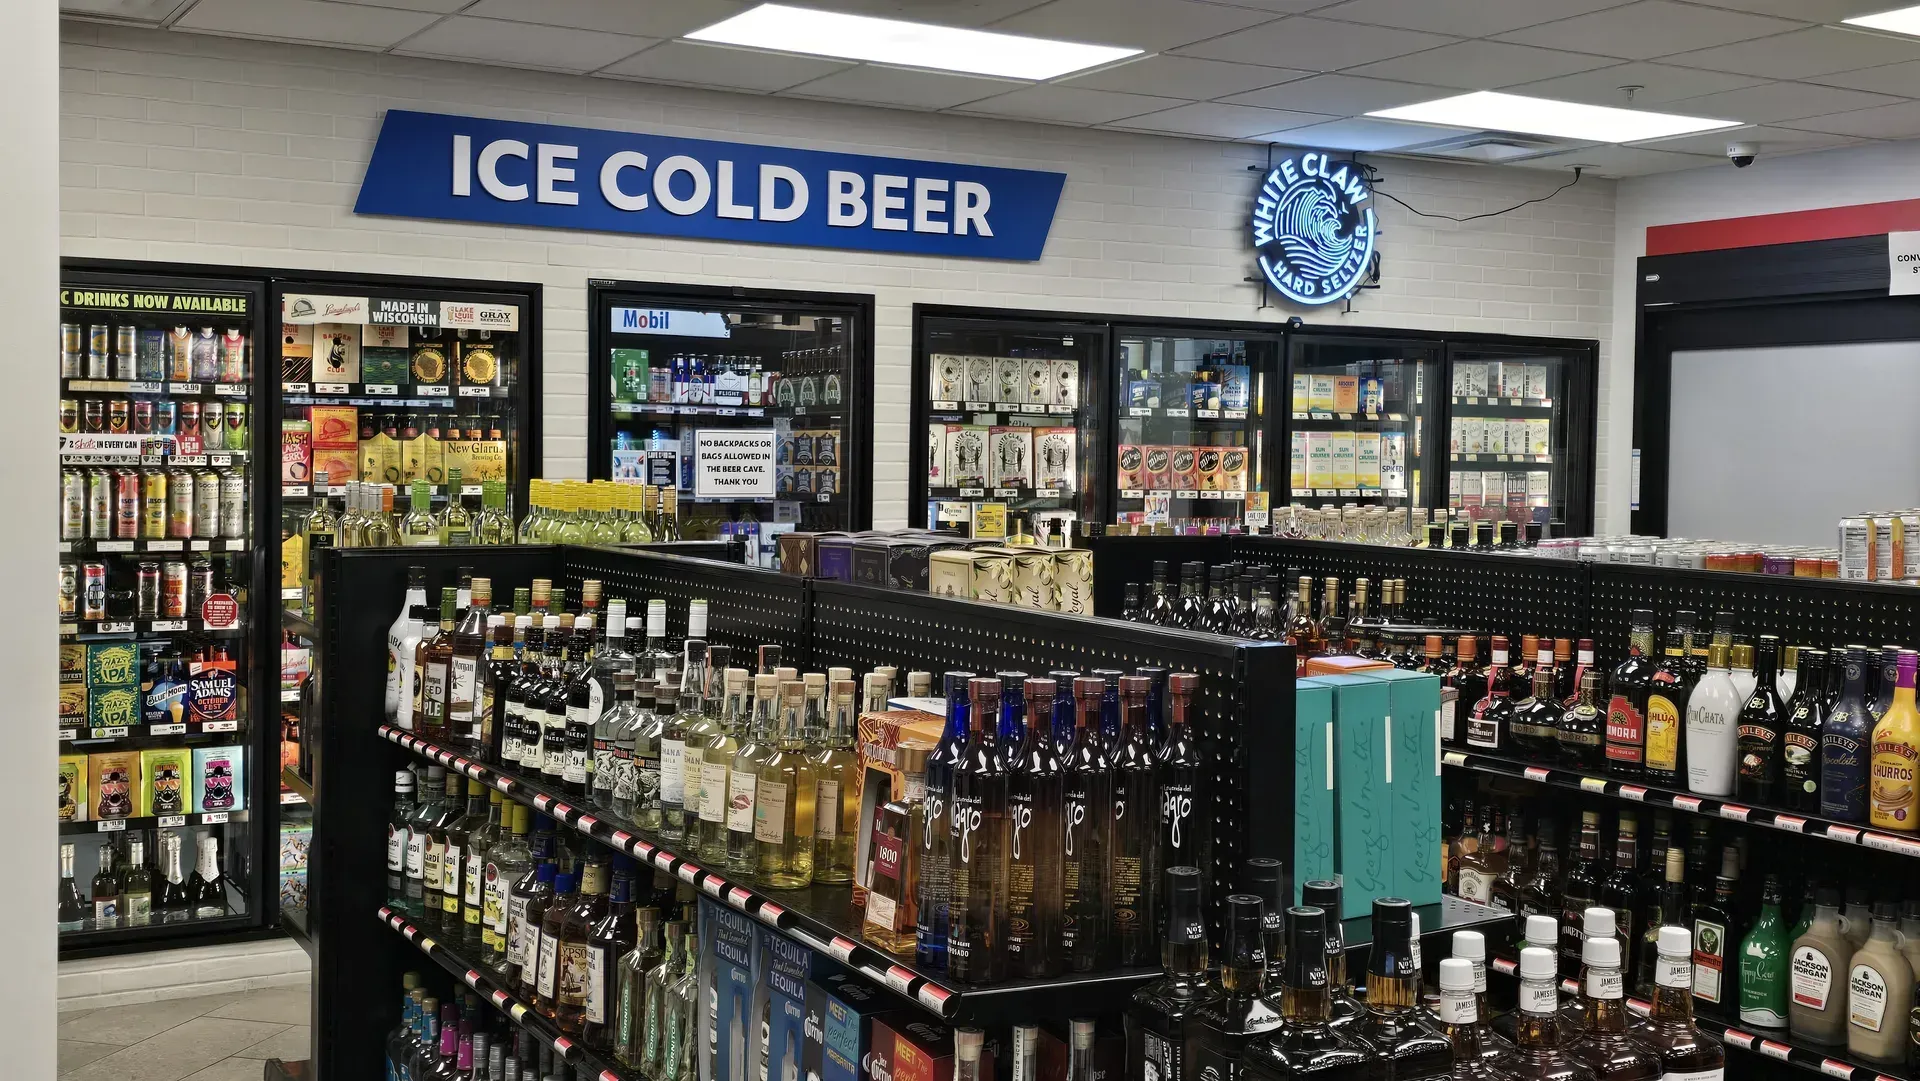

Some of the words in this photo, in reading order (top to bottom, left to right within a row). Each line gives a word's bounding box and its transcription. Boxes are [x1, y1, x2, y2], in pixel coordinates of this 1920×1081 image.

[452, 134, 578, 205] ICE
[600, 150, 809, 222] COLD
[827, 170, 993, 237] BEER
[1253, 159, 1299, 246] WHITE
[1302, 153, 1368, 204] CLAW
[1273, 260, 1315, 295] HARD
[1321, 225, 1367, 294] SELTZER
[60, 290, 70, 305] C
[74, 291, 129, 307] DRINKS
[134, 294, 169, 309] NOW
[173, 297, 246, 313] AVAILABLE
[381, 301, 414, 313] MADE
[416, 303, 429, 314] IN
[373, 311, 437, 325] WISCONSIN
[480, 311, 511, 320] GRAY
[623, 309, 669, 329] Mobil
[323, 333, 352, 342] BADGER
[182, 384, 200, 392] $3.99
[97, 441, 103, 449] IN
[105, 441, 123, 449] EVERY
[125, 441, 137, 449] CAN
[448, 443, 470, 454] New
[471, 442, 504, 454] Glarus
[701, 440, 712, 448] NO
[713, 440, 759, 448] BACKPACKS
[760, 440, 772, 448] OR
[471, 454, 493, 462] Brewing
[742, 478, 758, 486] YOU
[103, 667, 126, 681] IPA
[191, 677, 235, 690] SAMUEL
[147, 693, 166, 706] BLUE
[168, 686, 186, 697] MOON
[195, 688, 231, 700] ADAMS
[197, 697, 228, 705] OCTOBER
[106, 710, 127, 724] IPA
[527, 748, 536, 756] 94
[554, 755, 564, 763] 94
[573, 756, 585, 766] 94
[1873, 763, 1913, 781] CHURROS
[1024, 794, 1032, 802] del
[1077, 791, 1085, 799] del
[879, 846, 897, 863] 1800
[1494, 896, 1508, 906] Evan
[1524, 904, 1538, 914] Evan
[715, 907, 752, 938] TEQUILA
[716, 940, 749, 967] TEQUILA
[771, 935, 809, 969] TEQUILA
[1794, 958, 1829, 973] JACKSON
[1794, 965, 1827, 979] MORGAN
[731, 967, 746, 984] Cuervo
[771, 971, 804, 1000] TEQUILA
[1852, 977, 1884, 992] JACKSON
[1743, 988, 1768, 996] SHAMROCK
[1852, 984, 1882, 1000] MORGAN
[829, 1000, 848, 1023] MEET
[804, 1016, 824, 1044] Cuervo
[826, 1022, 857, 1050] perfect
[895, 1039, 916, 1064] MEET
[826, 1048, 855, 1075] MARGARITA
